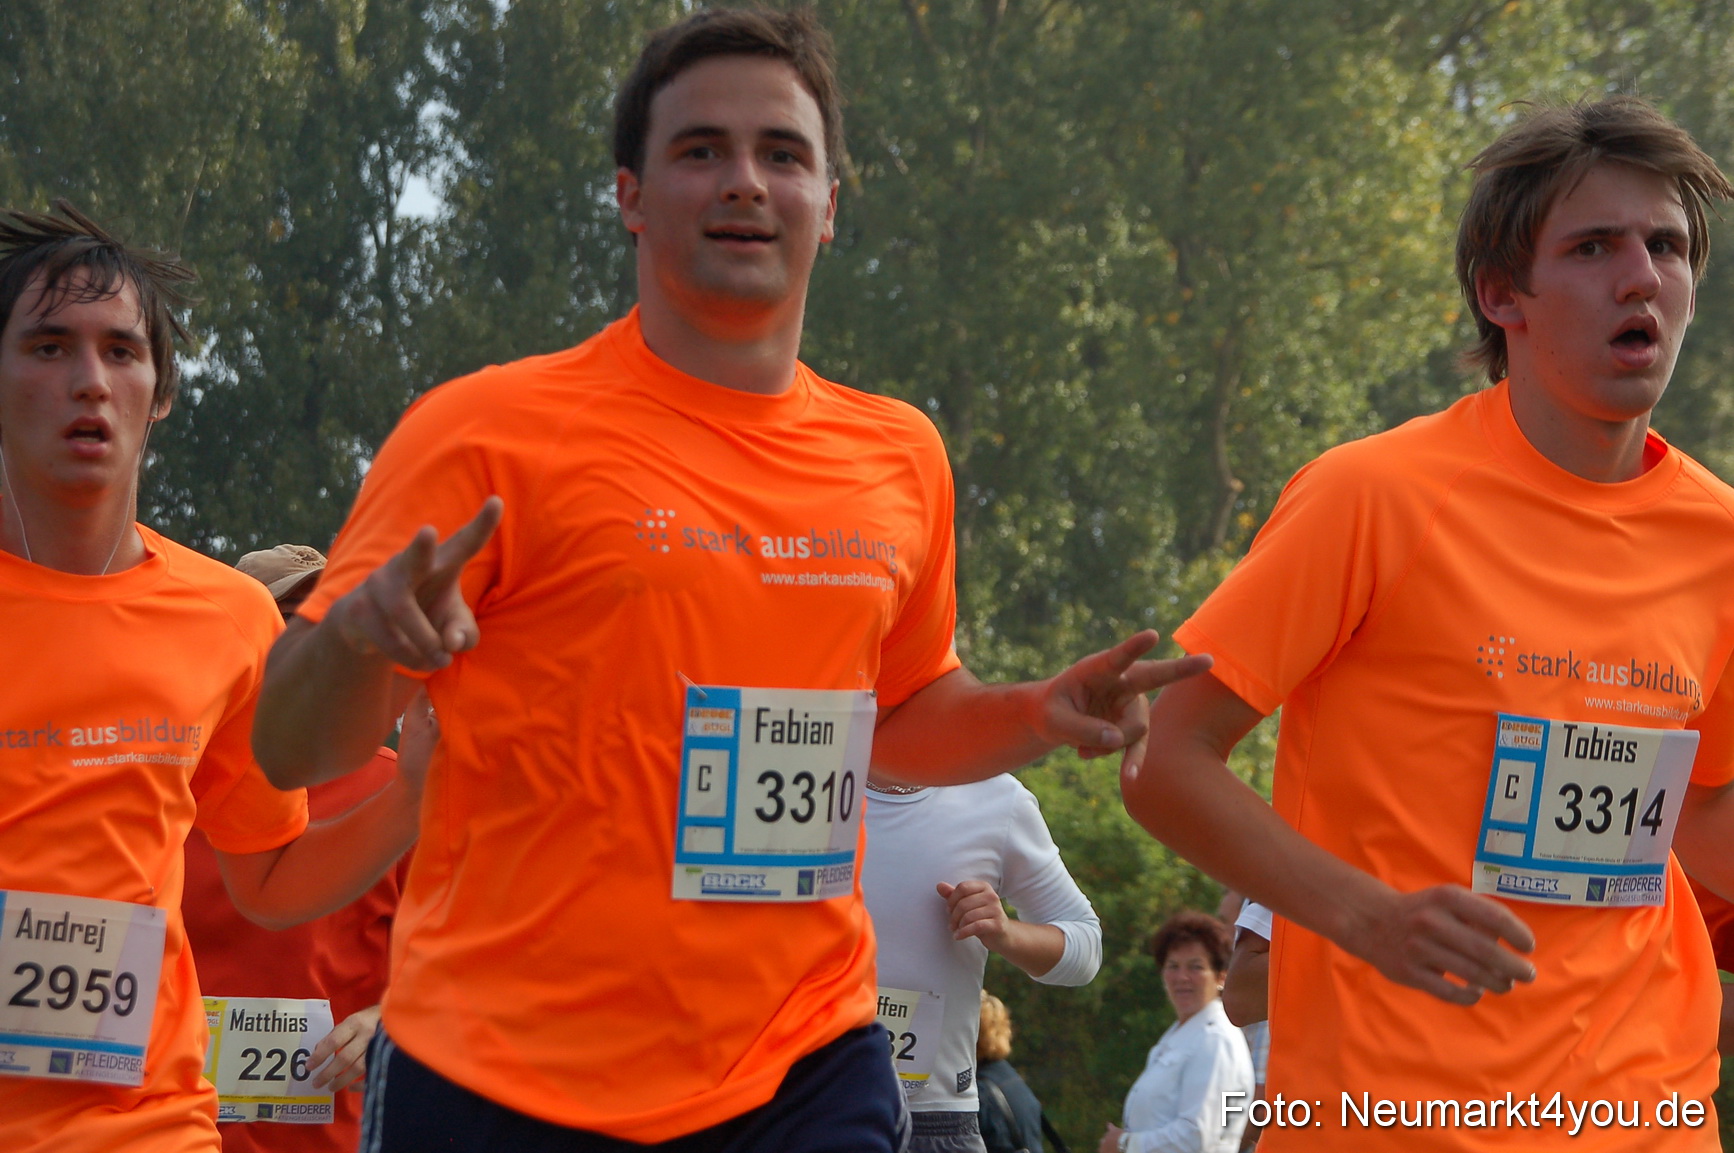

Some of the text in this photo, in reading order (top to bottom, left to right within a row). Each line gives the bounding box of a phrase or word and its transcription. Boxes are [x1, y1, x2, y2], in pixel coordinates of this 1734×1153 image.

[681, 525, 898, 574] stark ausbildung
[1516, 650, 1581, 679] stark
[71, 717, 202, 752] ausbildung
[755, 707, 835, 745] Fabian
[1563, 723, 1638, 763] Tobias
[697, 764, 712, 792] C
[1504, 774, 1520, 800] C
[755, 770, 855, 824] 3310
[1555, 782, 1667, 836] 3314
[701, 872, 767, 889] BOCK
[1497, 873, 1559, 893] BOCK
[1607, 876, 1663, 893] PFLEIDERER
[15, 907, 107, 953] Andrej
[8, 961, 139, 1017] 2959
[229, 1008, 308, 1033] Matthias
[876, 995, 908, 1018] ffen
[75, 1052, 142, 1073] PFLEIDERER
[238, 1047, 311, 1081] 226
[275, 1104, 332, 1115] PFLEIDERER
